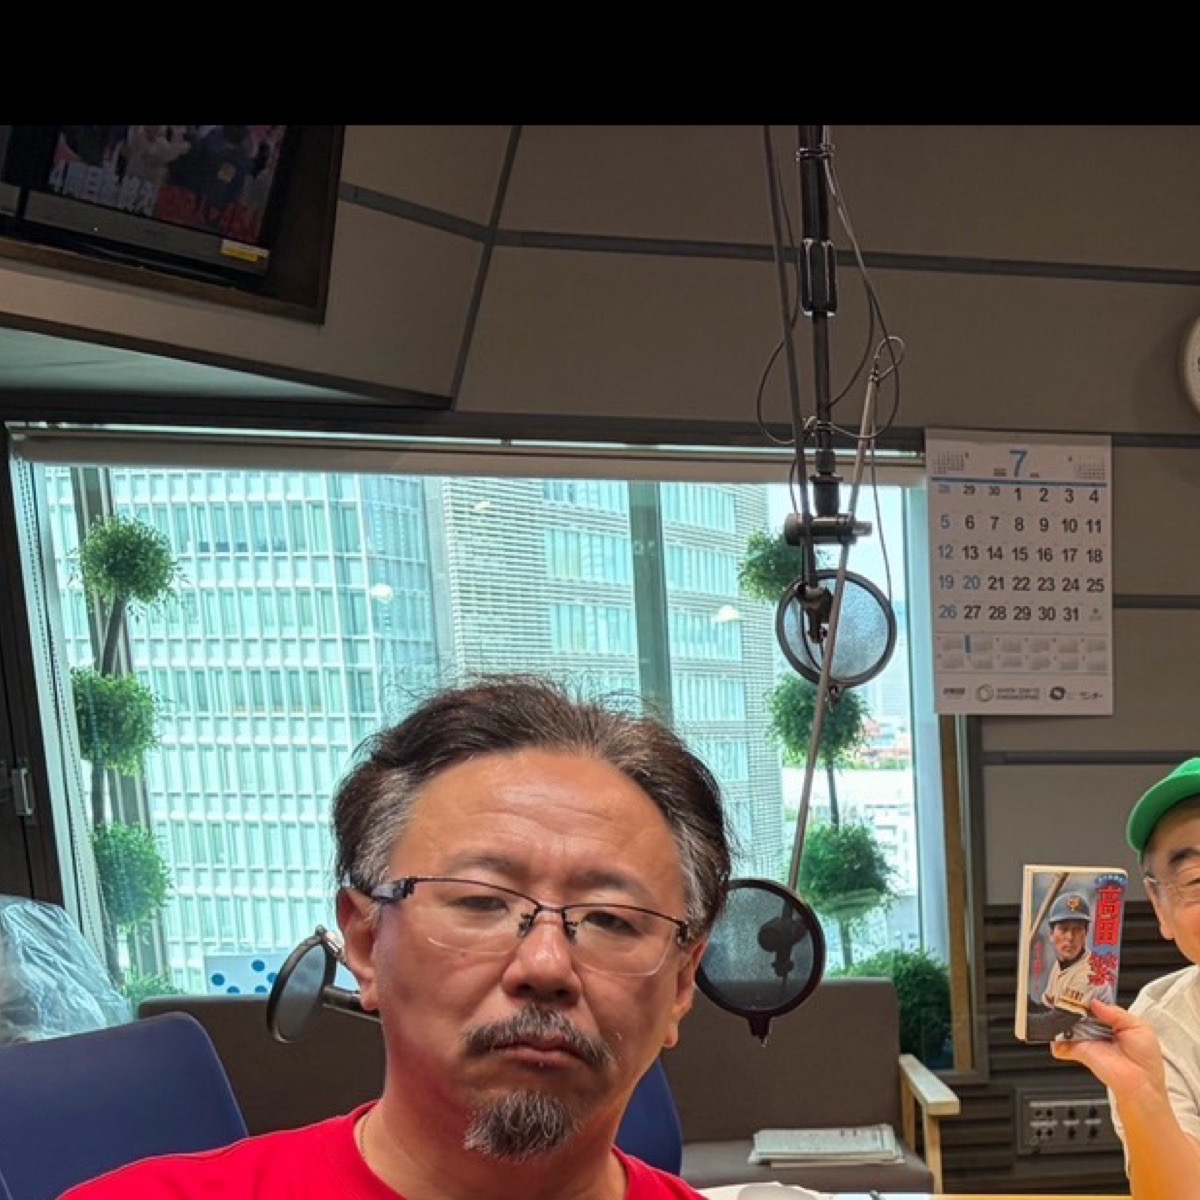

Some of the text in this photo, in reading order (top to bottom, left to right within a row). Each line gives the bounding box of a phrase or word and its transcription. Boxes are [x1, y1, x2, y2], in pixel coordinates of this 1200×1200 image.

[1009, 449, 1028, 478] 7
[1014, 487, 1023, 502] 1
[1039, 487, 1050, 502] 2
[1064, 488, 1075, 503] 3
[1088, 489, 1100, 503] 4
[940, 514, 1103, 534] 5 6 7 8 9 10 11
[937, 545, 1104, 564] 12 13 14 15 16 17 18
[938, 574, 1106, 594] 19 20 21 22 23 24 25
[938, 604, 1080, 622] 26 27 28 29 30 31
